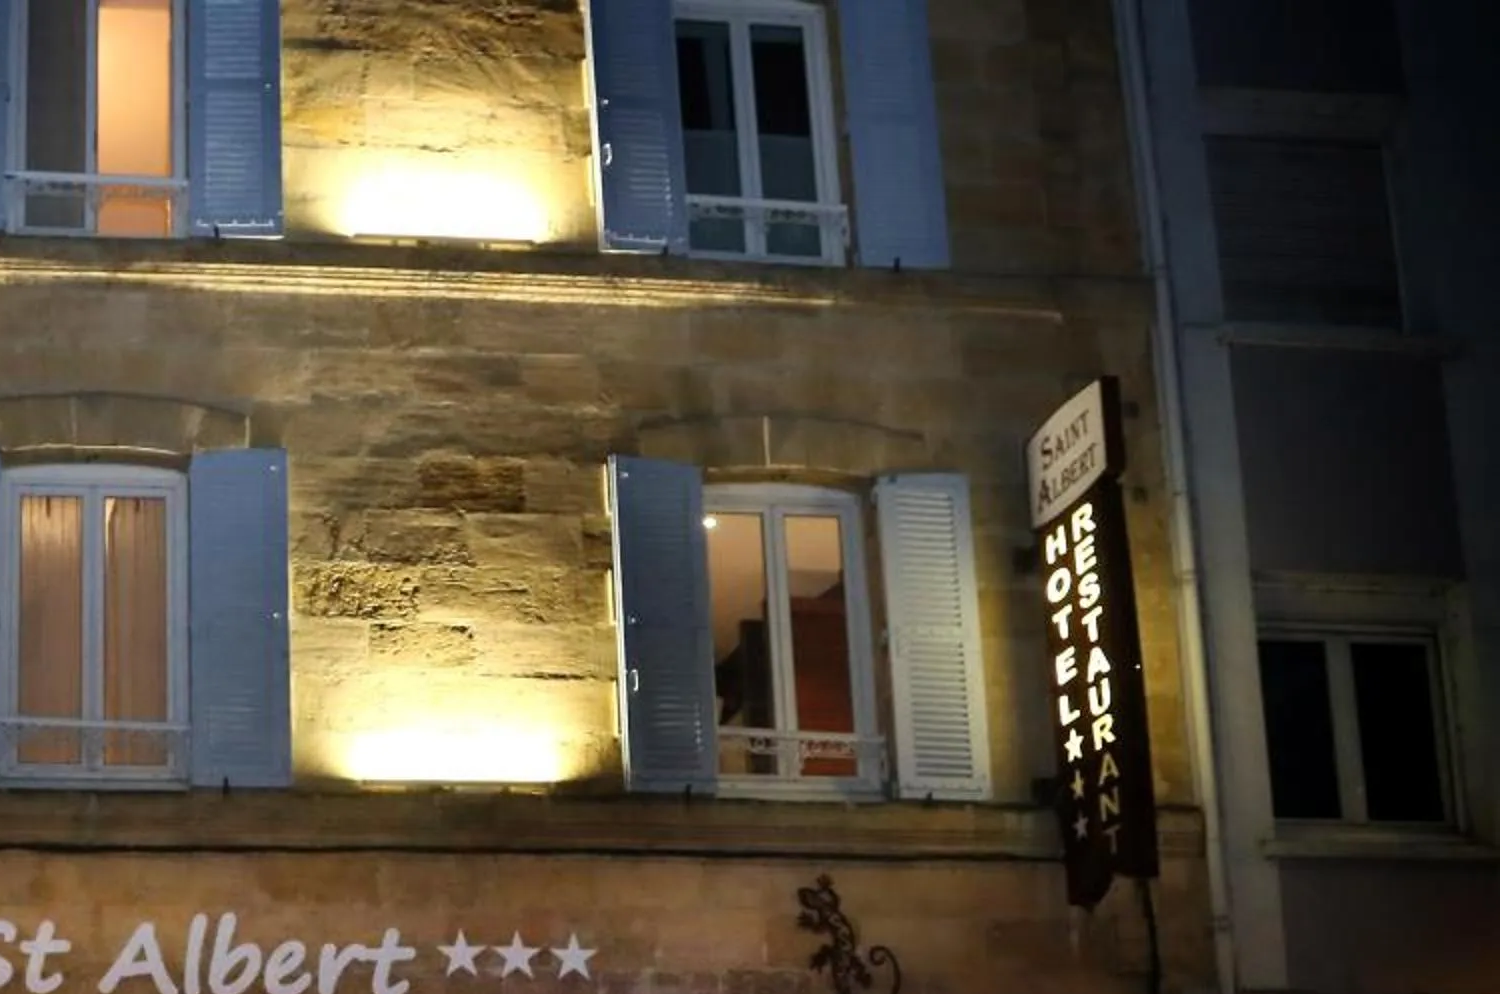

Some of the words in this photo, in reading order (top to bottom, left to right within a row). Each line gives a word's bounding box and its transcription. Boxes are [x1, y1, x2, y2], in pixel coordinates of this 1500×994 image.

[1038, 441, 1097, 515] ALBERT
[1041, 408, 1089, 471] SAINT
[1045, 531, 1081, 728] HOTEL
[1070, 500, 1118, 856] RESTAURANT
